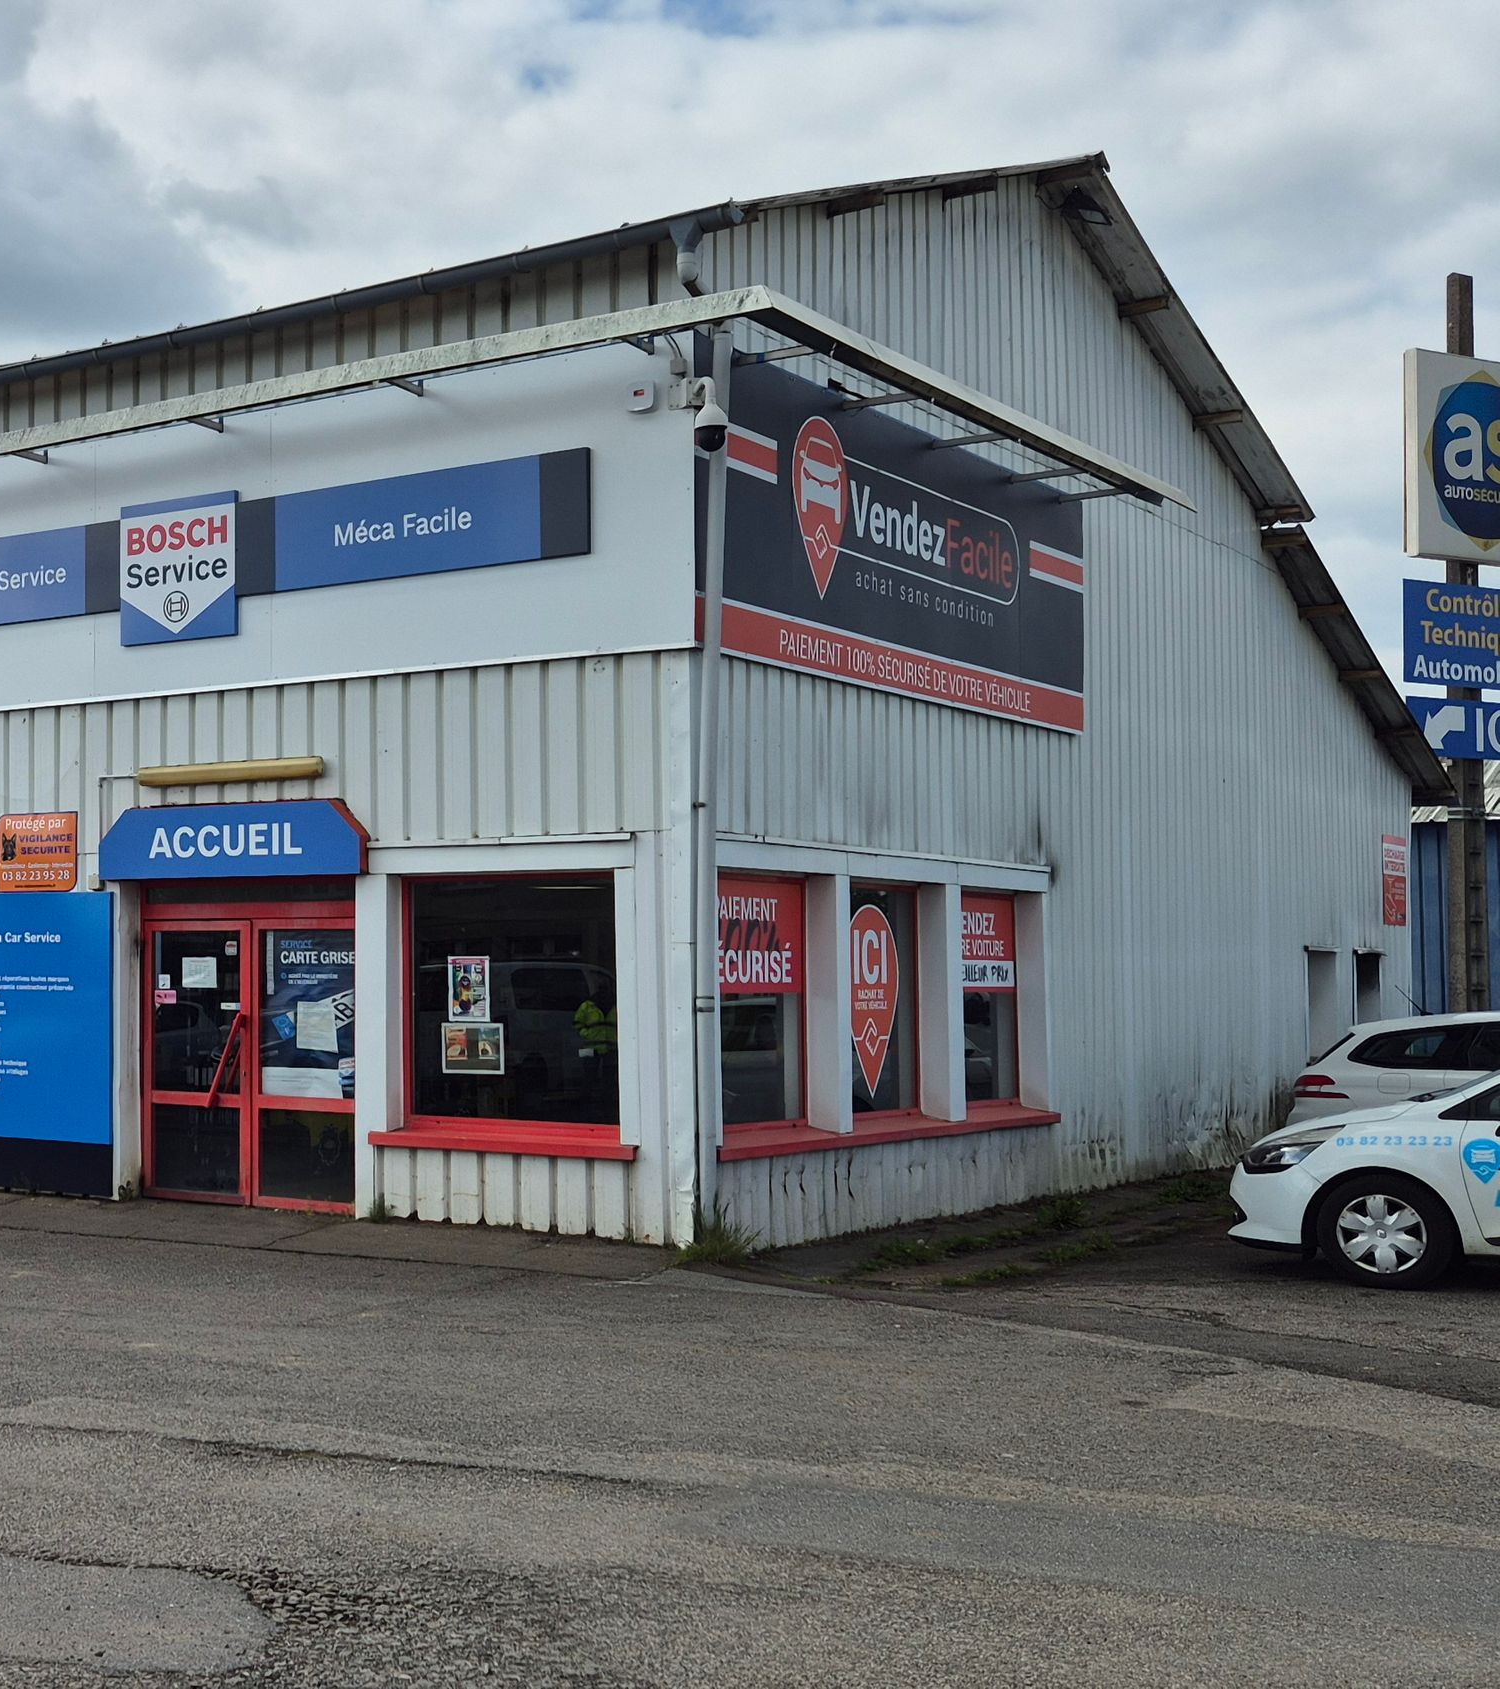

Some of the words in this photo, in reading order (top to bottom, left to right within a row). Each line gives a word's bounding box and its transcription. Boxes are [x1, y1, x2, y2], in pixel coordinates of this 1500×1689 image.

[127, 515, 227, 556] BOSCH
[334, 519, 395, 547] Méca
[403, 506, 472, 537] Facile
[126, 554, 227, 589] Service
[856, 571, 893, 597] achat
[900, 585, 929, 608] sans
[935, 596, 994, 627] condition
[780, 629, 844, 668] PAIEMENT
[846, 646, 876, 677] 100%
[878, 651, 931, 690] SÉCURISÉ
[933, 669, 947, 694] DE
[949, 672, 983, 702] VOTRE
[985, 676, 1031, 713] VÉHICULE
[5, 816, 45, 831] Protégé
[48, 818, 67, 831] par
[19, 833, 73, 843] VIGILANCE
[149, 822, 302, 859] ACCUEIL
[2, 871, 13, 881] 03
[15, 871, 27, 881] 82
[29, 871, 41, 881] 23
[43, 870, 55, 880] 95
[57, 869, 70, 880] 28
[962, 912, 995, 936] ENDEZ
[5, 932, 22, 943] Car
[24, 931, 61, 943] Service
[281, 940, 313, 949] SERVICE
[972, 939, 1004, 957] VOITURE
[280, 951, 318, 964] CARTE
[320, 951, 355, 965] GRISE
[717, 941, 792, 983] ÉCURISÉ
[854, 929, 887, 984] ICI
[1336, 1137, 1354, 1147] 03
[1359, 1136, 1378, 1146] 82
[1384, 1136, 1403, 1146] 23
[1408, 1136, 1427, 1146] 23
[1433, 1136, 1453, 1146] 23
